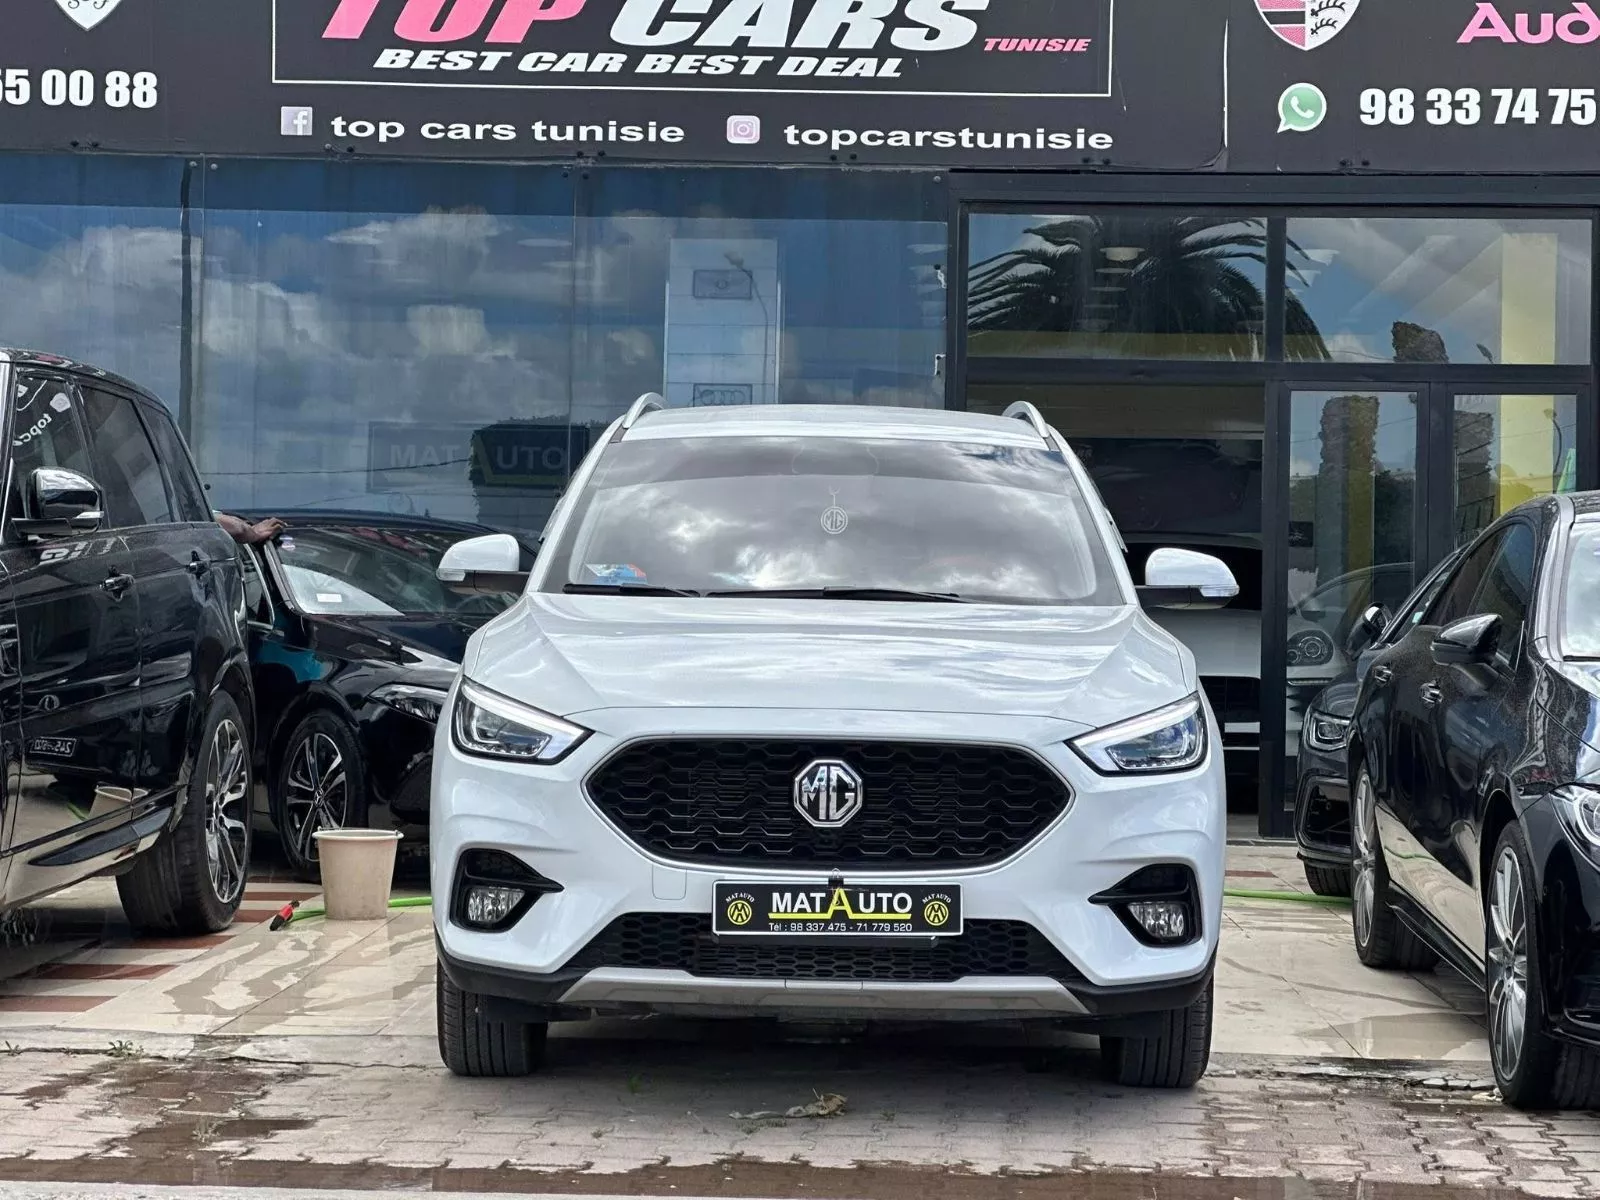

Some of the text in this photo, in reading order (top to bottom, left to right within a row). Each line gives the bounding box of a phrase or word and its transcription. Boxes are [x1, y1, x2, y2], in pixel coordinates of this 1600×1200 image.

[609, 0, 991, 52] CARS
[983, 38, 1092, 53] TUNISIE
[372, 49, 902, 78] BEST CAR BEST DEAL
[0, 69, 158, 109] 5 00 88
[1359, 87, 1597, 126] 98 33 74 75
[330, 115, 686, 143] top cars tunisie
[783, 123, 1114, 151] topcarstunisie
[390, 444, 462, 468] MAT
[800, 764, 857, 821] MG
[725, 892, 755, 903] MAT AUTO
[772, 892, 826, 913] MAT
[828, 888, 912, 918] AUTO
[922, 893, 952, 904] MAT AUTO
[790, 922, 803, 932] 98
[806, 922, 825, 932] 337
[828, 922, 847, 932] 475
[857, 922, 868, 932] 71
[872, 922, 891, 932] 779
[893, 922, 913, 932] 520
